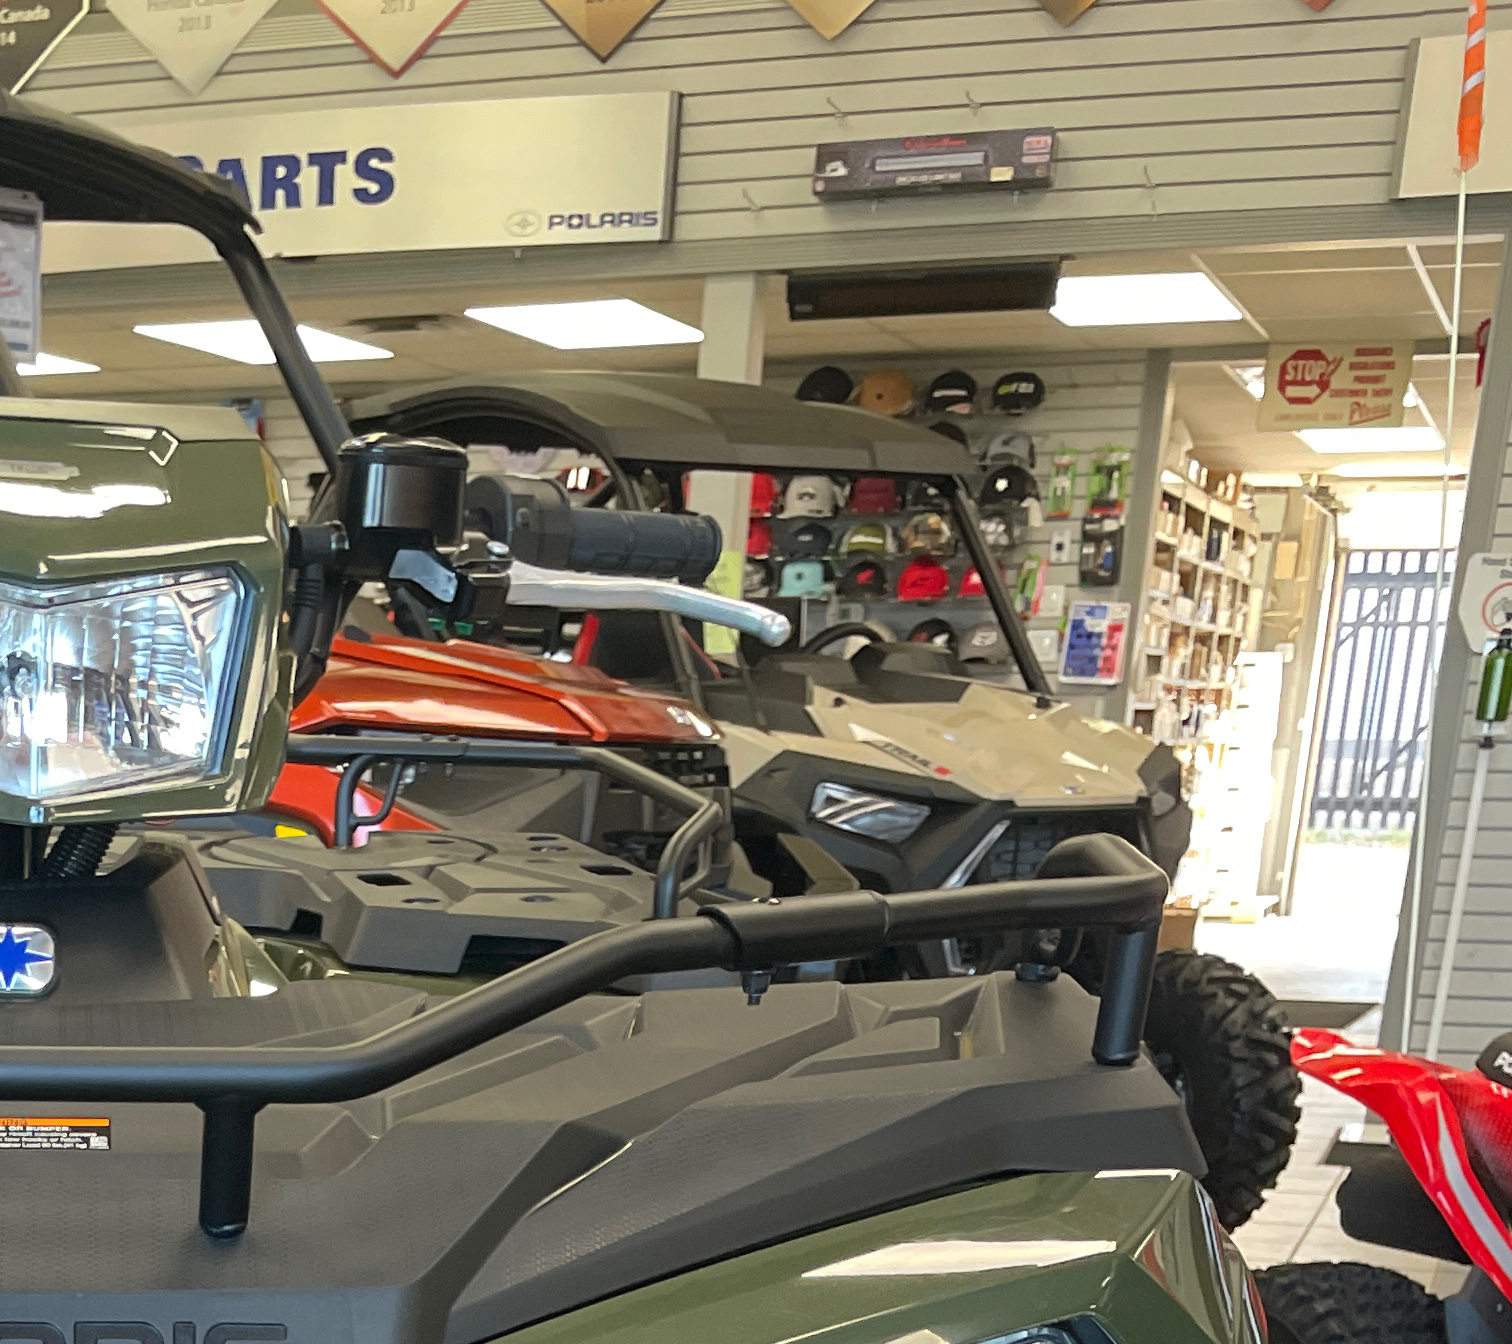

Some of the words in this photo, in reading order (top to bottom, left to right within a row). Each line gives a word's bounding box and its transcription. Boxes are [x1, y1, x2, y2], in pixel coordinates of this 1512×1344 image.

[0, 5, 51, 24] Canada
[174, 147, 396, 213] ARTS
[547, 210, 659, 230] POLARIS
[1285, 360, 1327, 381] STOP
